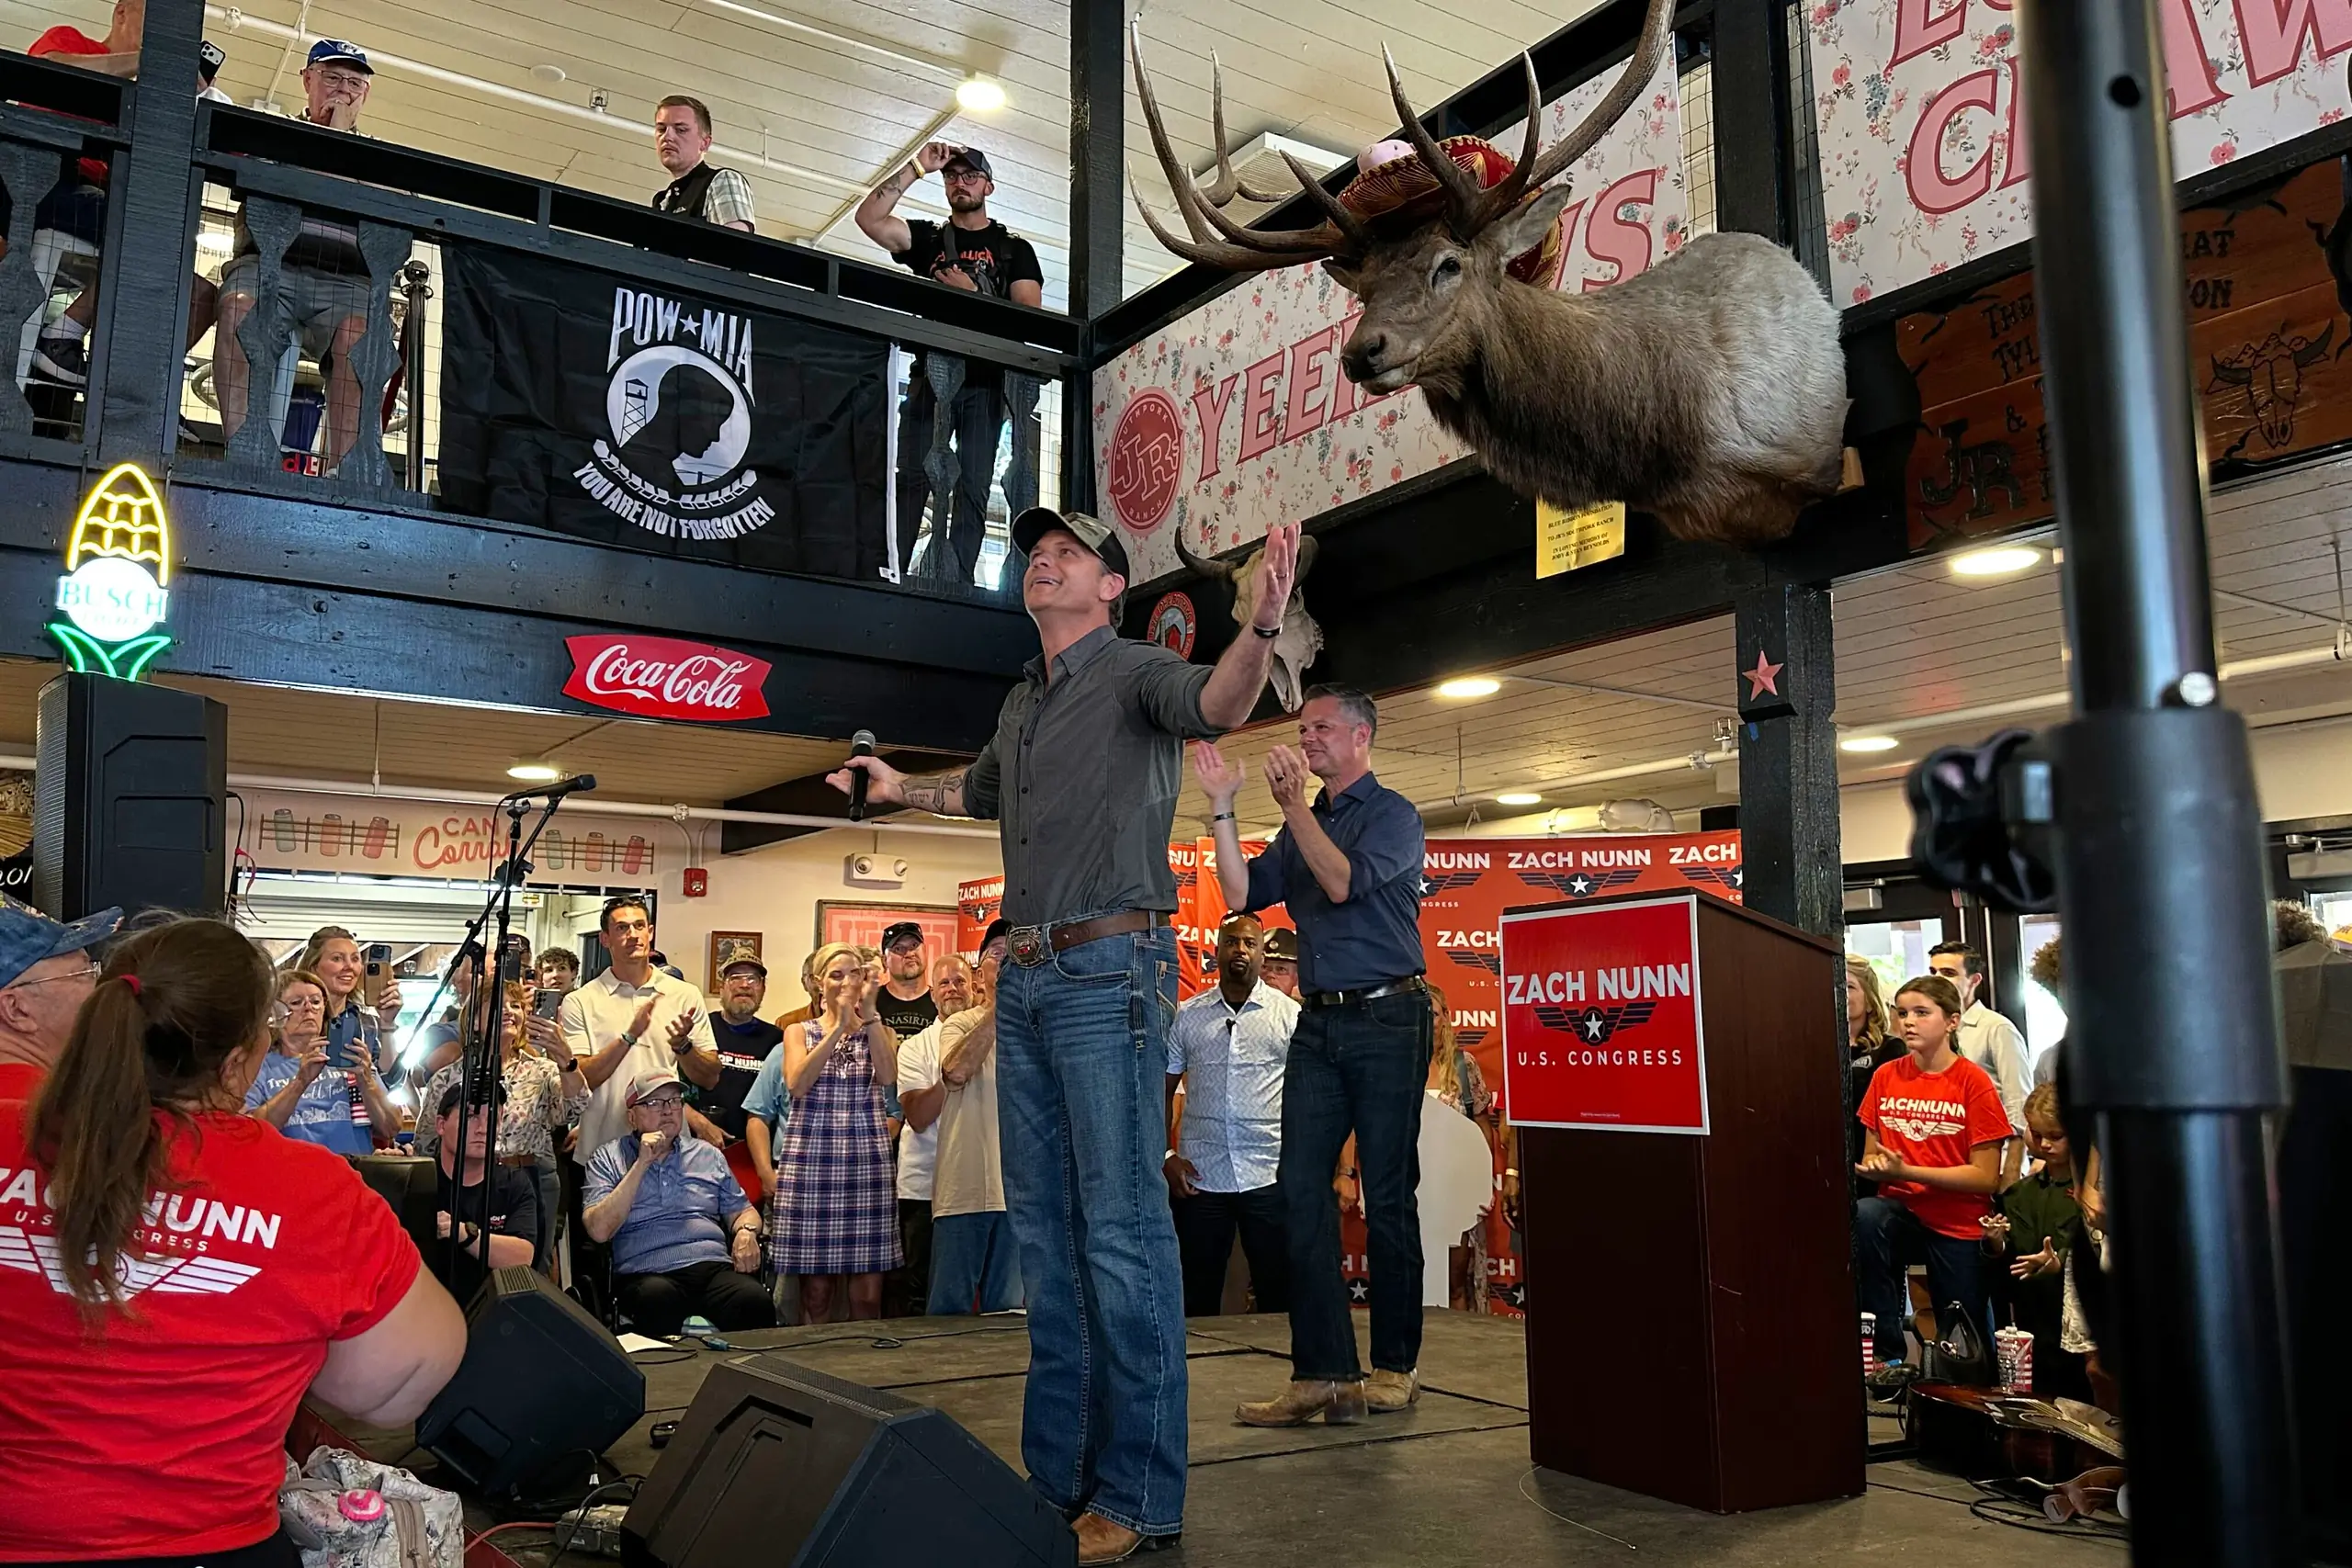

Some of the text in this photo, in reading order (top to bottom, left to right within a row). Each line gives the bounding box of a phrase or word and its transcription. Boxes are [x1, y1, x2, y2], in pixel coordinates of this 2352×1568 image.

[607, 287, 755, 407] POW MIA
[1116, 402, 1170, 461] SOUTHPORK
[573, 461, 775, 540] YOU ARE NOT FORGOTTEN
[1128, 499, 1163, 521] RANCH
[1596, 517, 1614, 526] RANCH
[62, 581, 164, 616] BUSCH
[585, 644, 752, 710] Coca-Cola
[443, 818, 499, 837] CAN
[1168, 850, 1197, 867] NU
[1423, 842, 1737, 869] NUNN ZACH NUNN ZACH
[958, 881, 1005, 902] ZACH NUNN
[1177, 924, 1198, 942] ZA
[1437, 931, 1500, 947] ZACH
[1507, 963, 1690, 1005] ZACH NUNN
[885, 1015, 933, 1028] NASIRIY
[1451, 1010, 1496, 1028] UNN
[1518, 1049, 1682, 1066] U.S. CONGRESS
[266, 1077, 290, 1090] Try
[132, 1229, 209, 1252] GRESS
[1486, 1258, 1516, 1276] CH
